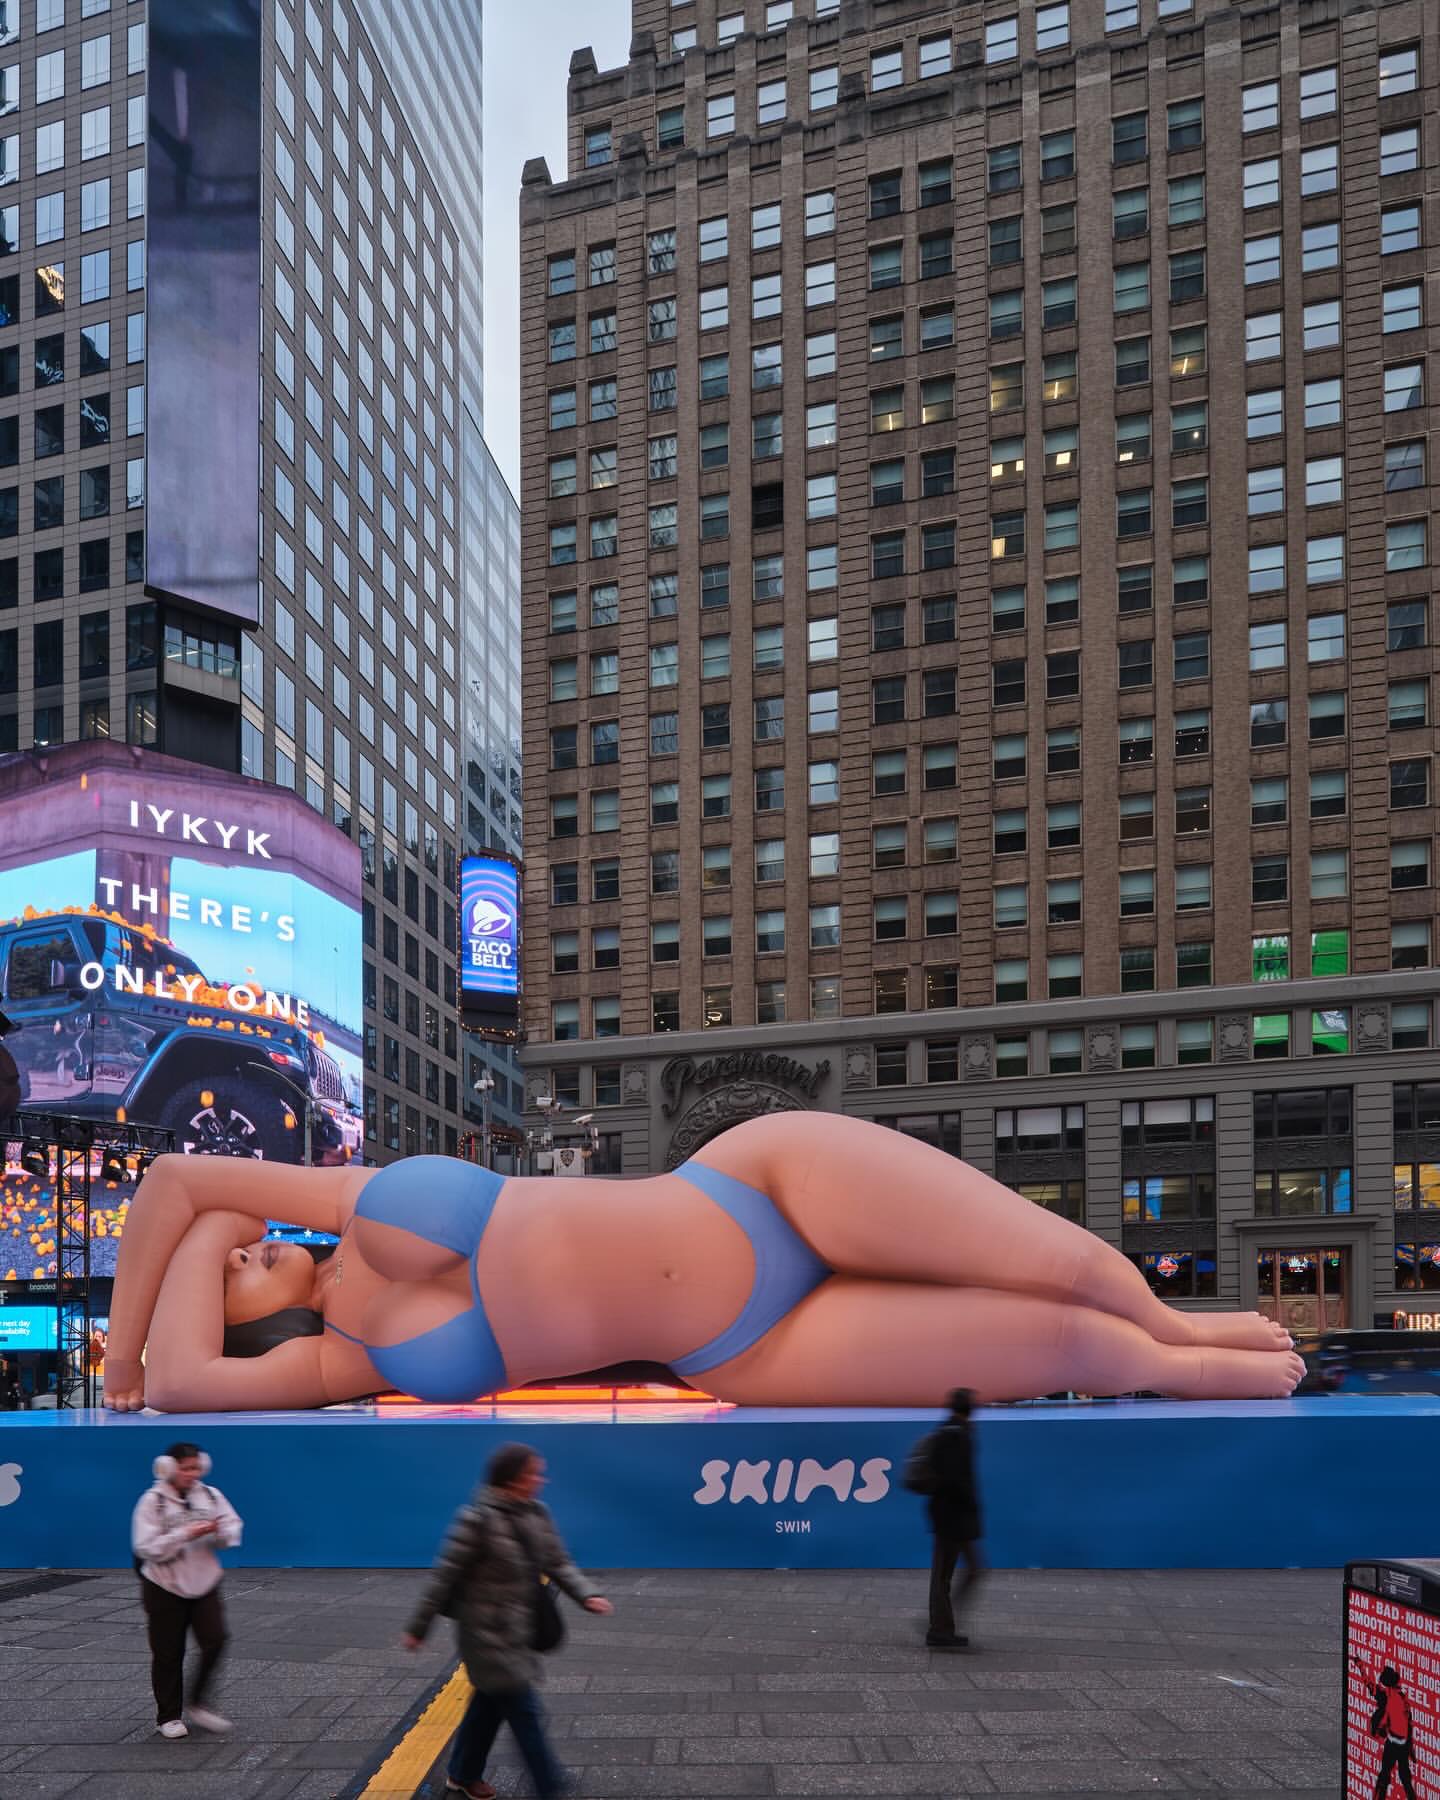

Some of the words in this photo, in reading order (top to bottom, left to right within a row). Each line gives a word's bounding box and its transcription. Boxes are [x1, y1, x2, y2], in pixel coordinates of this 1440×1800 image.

[130, 800, 273, 859] IYKYK
[100, 877, 296, 942] THERE'S
[469, 939, 511, 956] TACO
[471, 954, 512, 969] BELL
[80, 962, 201, 1003] ONLY
[227, 984, 310, 1026] ONE
[660, 1052, 832, 1119] Paramount
[693, 1457, 892, 1504] SKIMS
[775, 1521, 811, 1533] SWIM
[1348, 1592, 1369, 1610] JAM
[1376, 1601, 1399, 1620] BAD
[1348, 1608, 1391, 1636] SMOOTH
[1348, 1626, 1367, 1646] BILLIE
[1348, 1642, 1372, 1665] BLAME
[1399, 1663, 1415, 1683] THE
[1347, 1694, 1376, 1718] DANC
[1347, 1775, 1373, 1800] HUM
